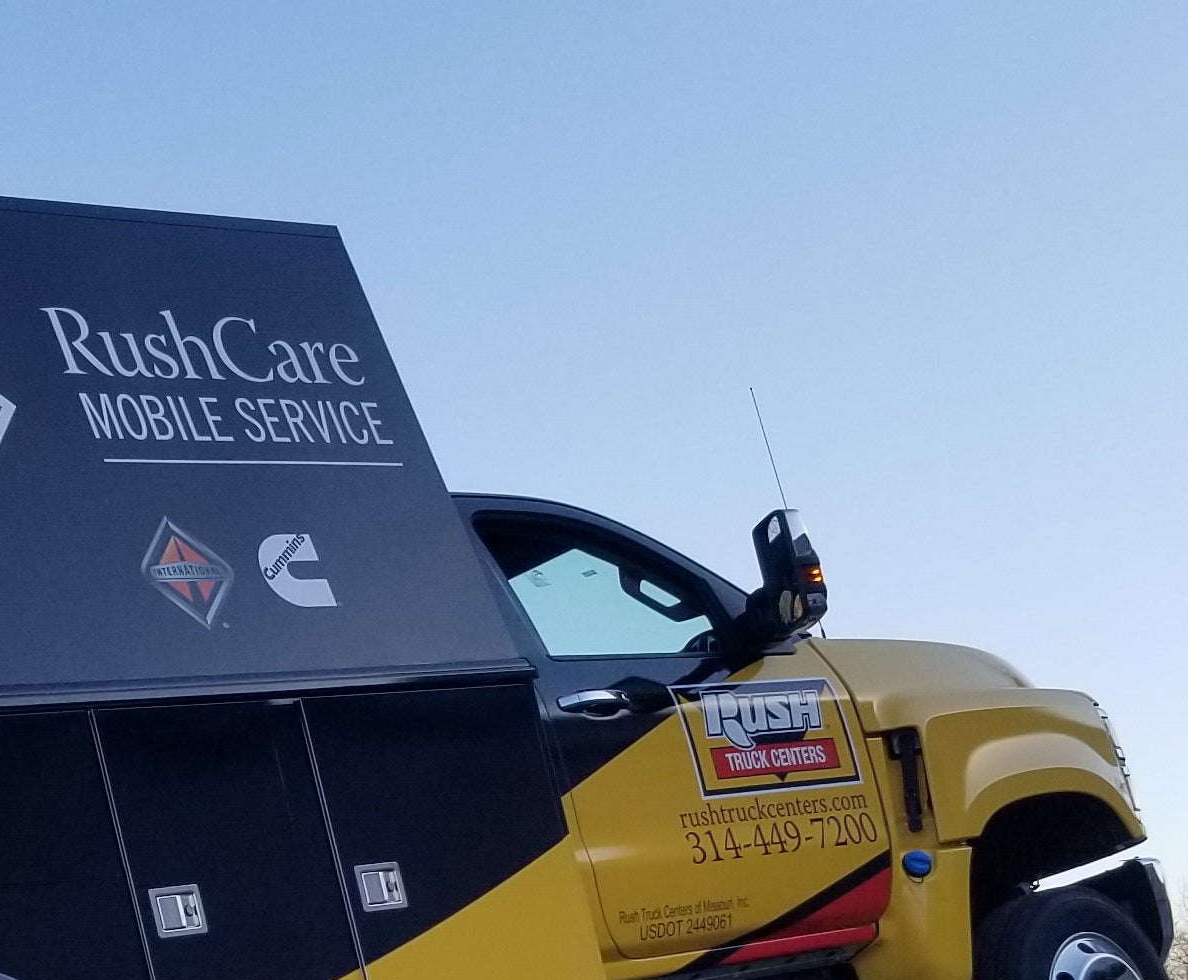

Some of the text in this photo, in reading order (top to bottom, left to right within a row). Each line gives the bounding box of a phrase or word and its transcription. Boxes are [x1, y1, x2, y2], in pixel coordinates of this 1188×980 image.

[39, 307, 365, 386] RushCare
[79, 393, 394, 445] MOBILE SERVICE
[263, 533, 306, 581] Cummins
[724, 746, 826, 771] TRUCK CENTERS
[680, 794, 868, 829] rushtruckcenters.com
[685, 812, 878, 864] 314-449-7200
[619, 910, 640, 924] Rush
[641, 907, 662, 921] Truck
[664, 905, 693, 919] Centers
[695, 902, 703, 914] of
[640, 914, 732, 940] USDOT 2449061
